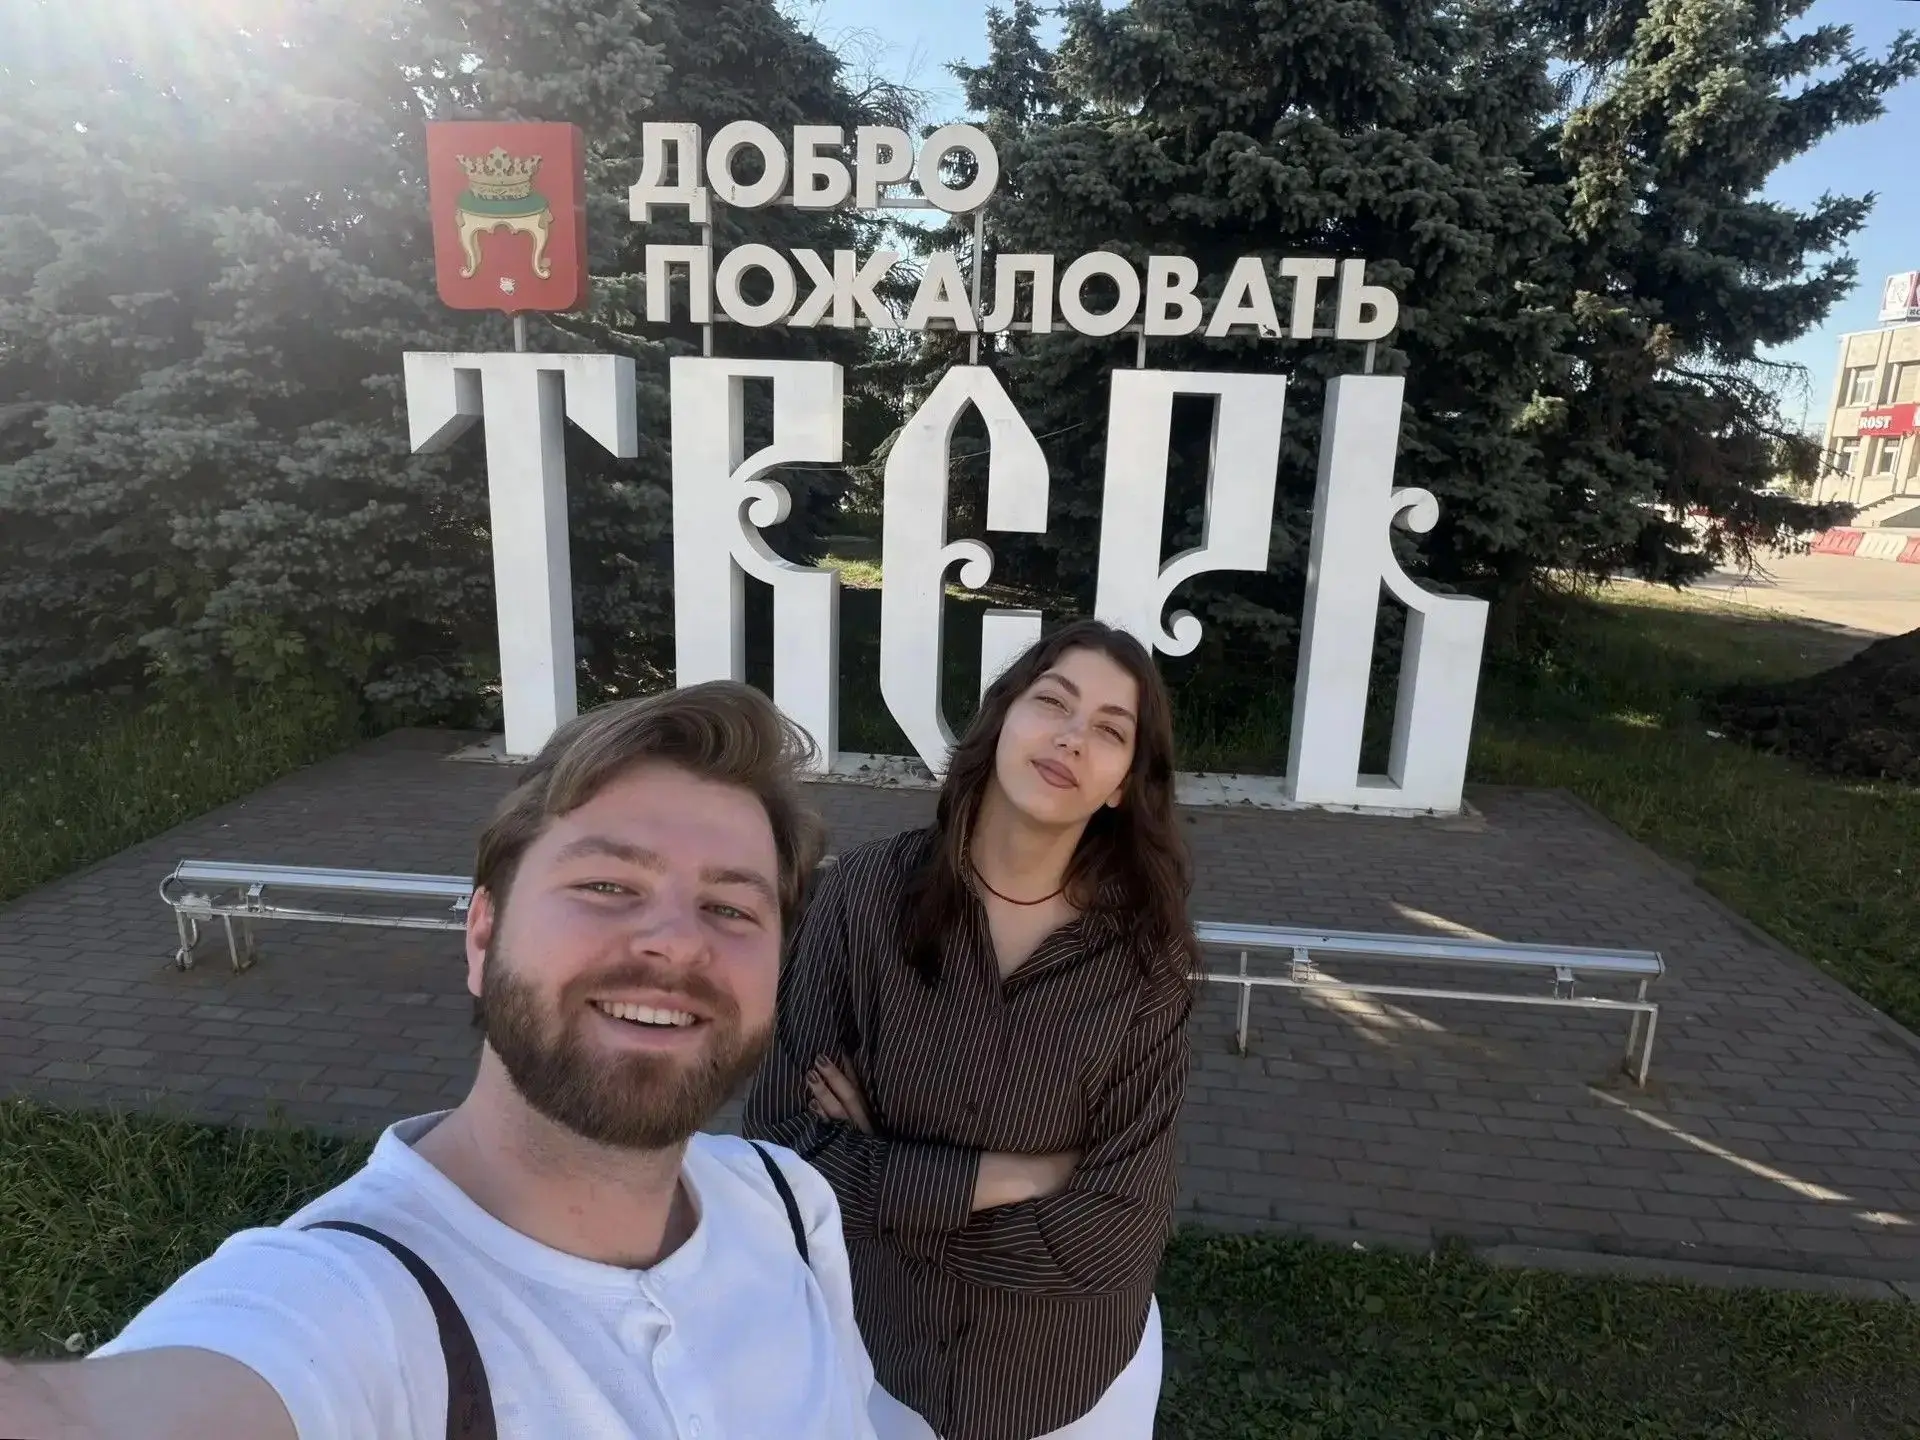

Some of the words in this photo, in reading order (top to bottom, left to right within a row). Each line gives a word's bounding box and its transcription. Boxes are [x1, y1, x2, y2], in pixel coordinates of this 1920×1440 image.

[629, 120, 999, 223] ДОБРО
[645, 243, 1399, 340] ПОЖАЛОВАТЬ
[1860, 415, 1892, 429] ROST
